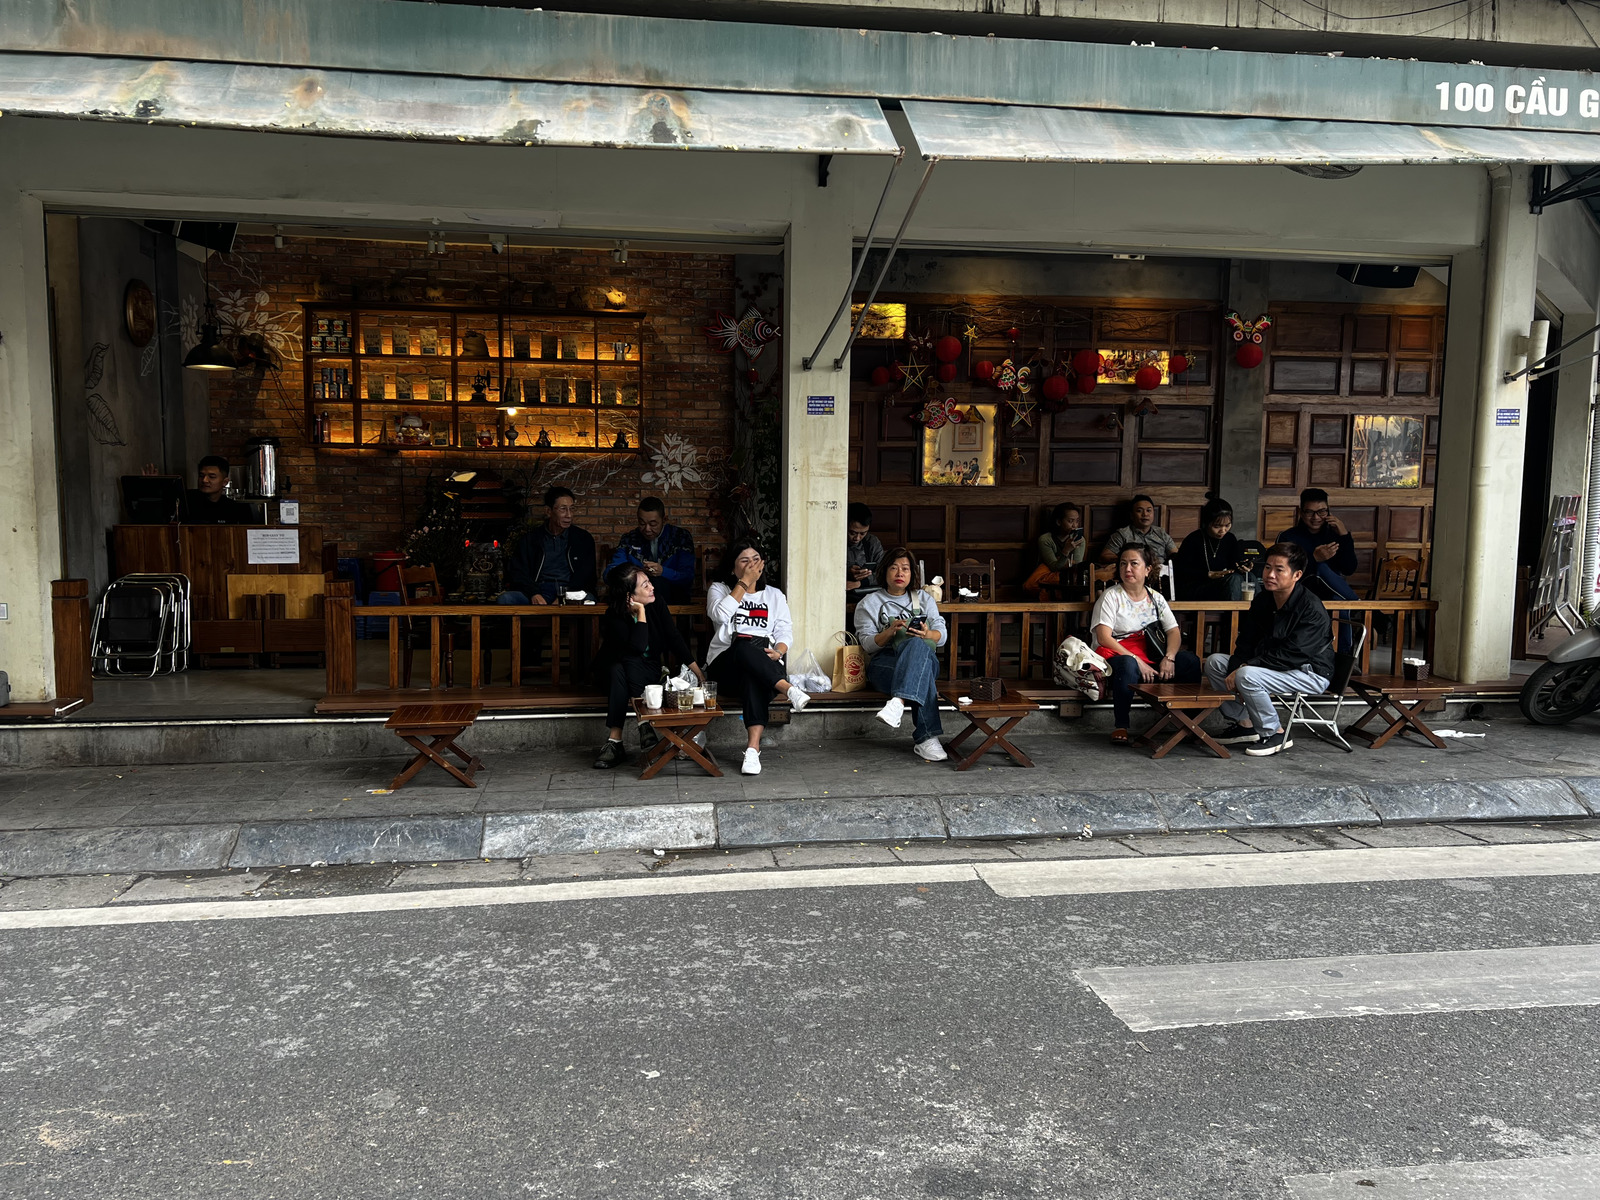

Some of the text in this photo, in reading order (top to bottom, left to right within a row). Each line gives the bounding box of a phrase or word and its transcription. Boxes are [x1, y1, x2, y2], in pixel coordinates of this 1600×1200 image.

[1435, 76, 1600, 118] 100 CẦU G
